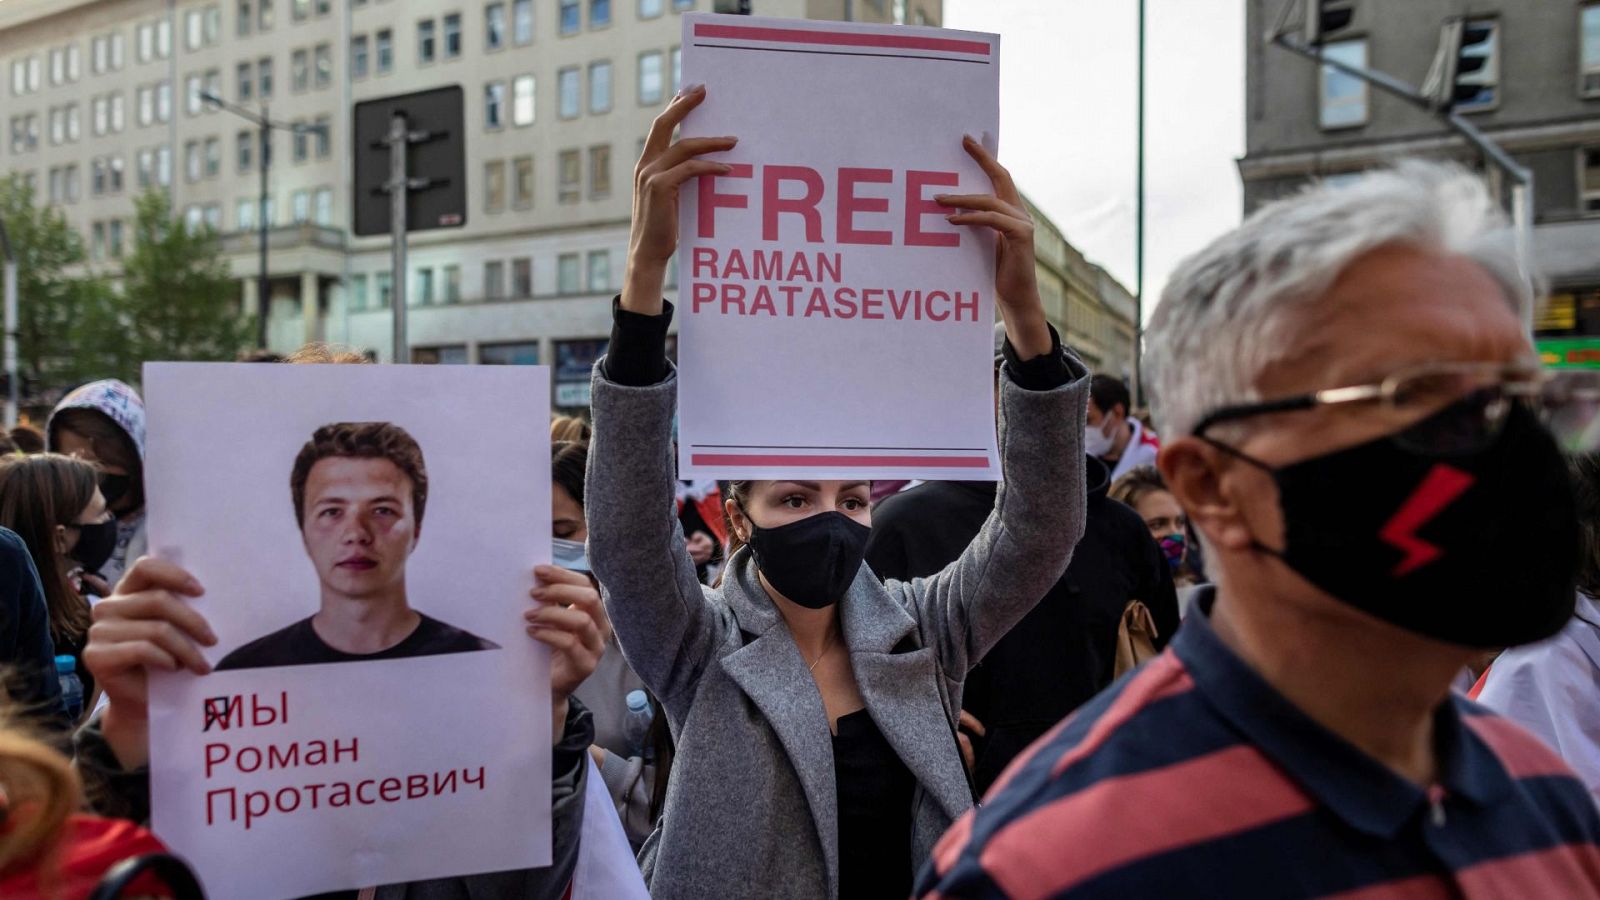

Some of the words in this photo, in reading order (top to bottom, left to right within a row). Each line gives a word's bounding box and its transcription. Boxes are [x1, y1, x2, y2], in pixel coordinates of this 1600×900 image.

[697, 164, 960, 247] FREE
[692, 247, 842, 283] RAMAN
[692, 283, 980, 321] PRATASEVICH
[204, 737, 359, 778] Роман
[206, 766, 485, 829] Протасевич
